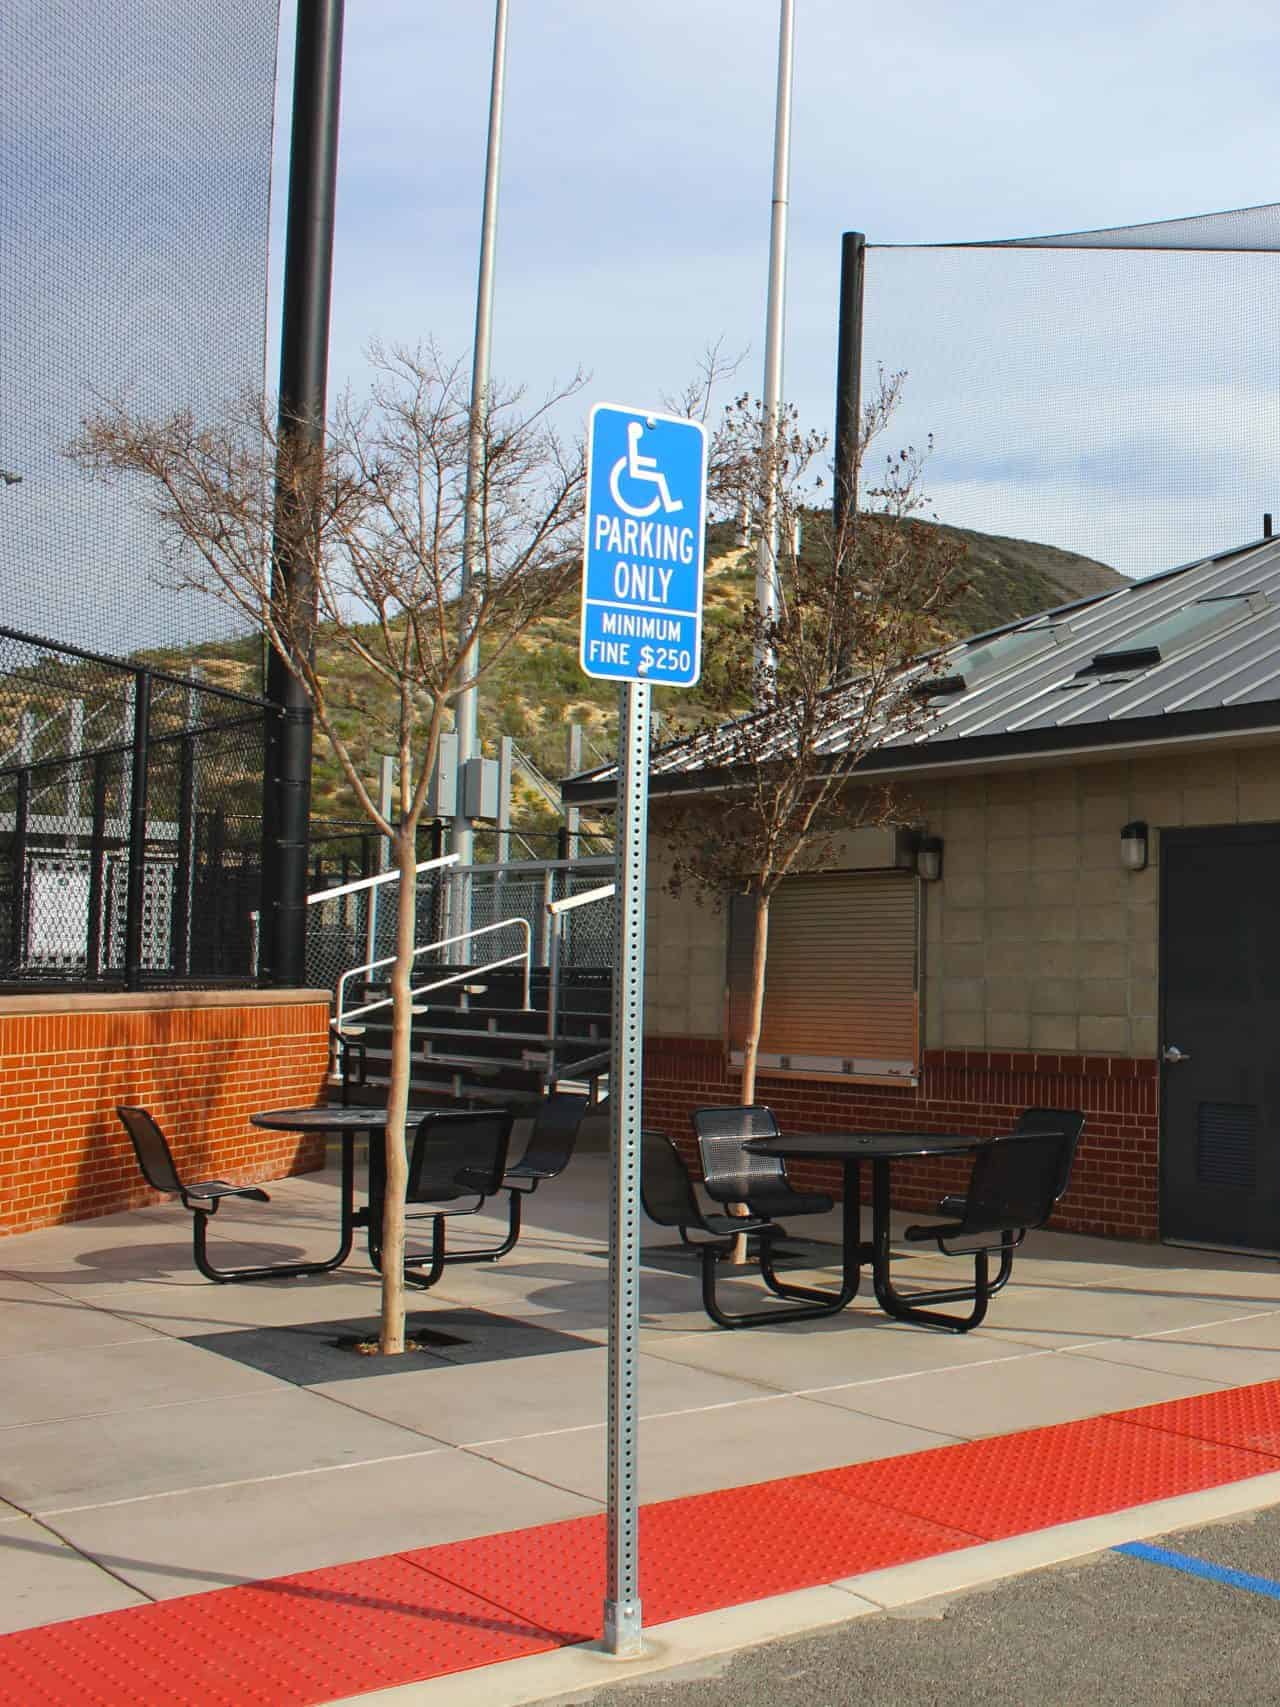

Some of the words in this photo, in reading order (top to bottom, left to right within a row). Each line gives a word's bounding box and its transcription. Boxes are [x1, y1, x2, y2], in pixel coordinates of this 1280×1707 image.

[595, 514, 694, 564] PARKING
[614, 561, 673, 604] ONLY
[602, 612, 682, 643] MINIMUM
[589, 639, 631, 665] FINE
[640, 645, 691, 672] $250
